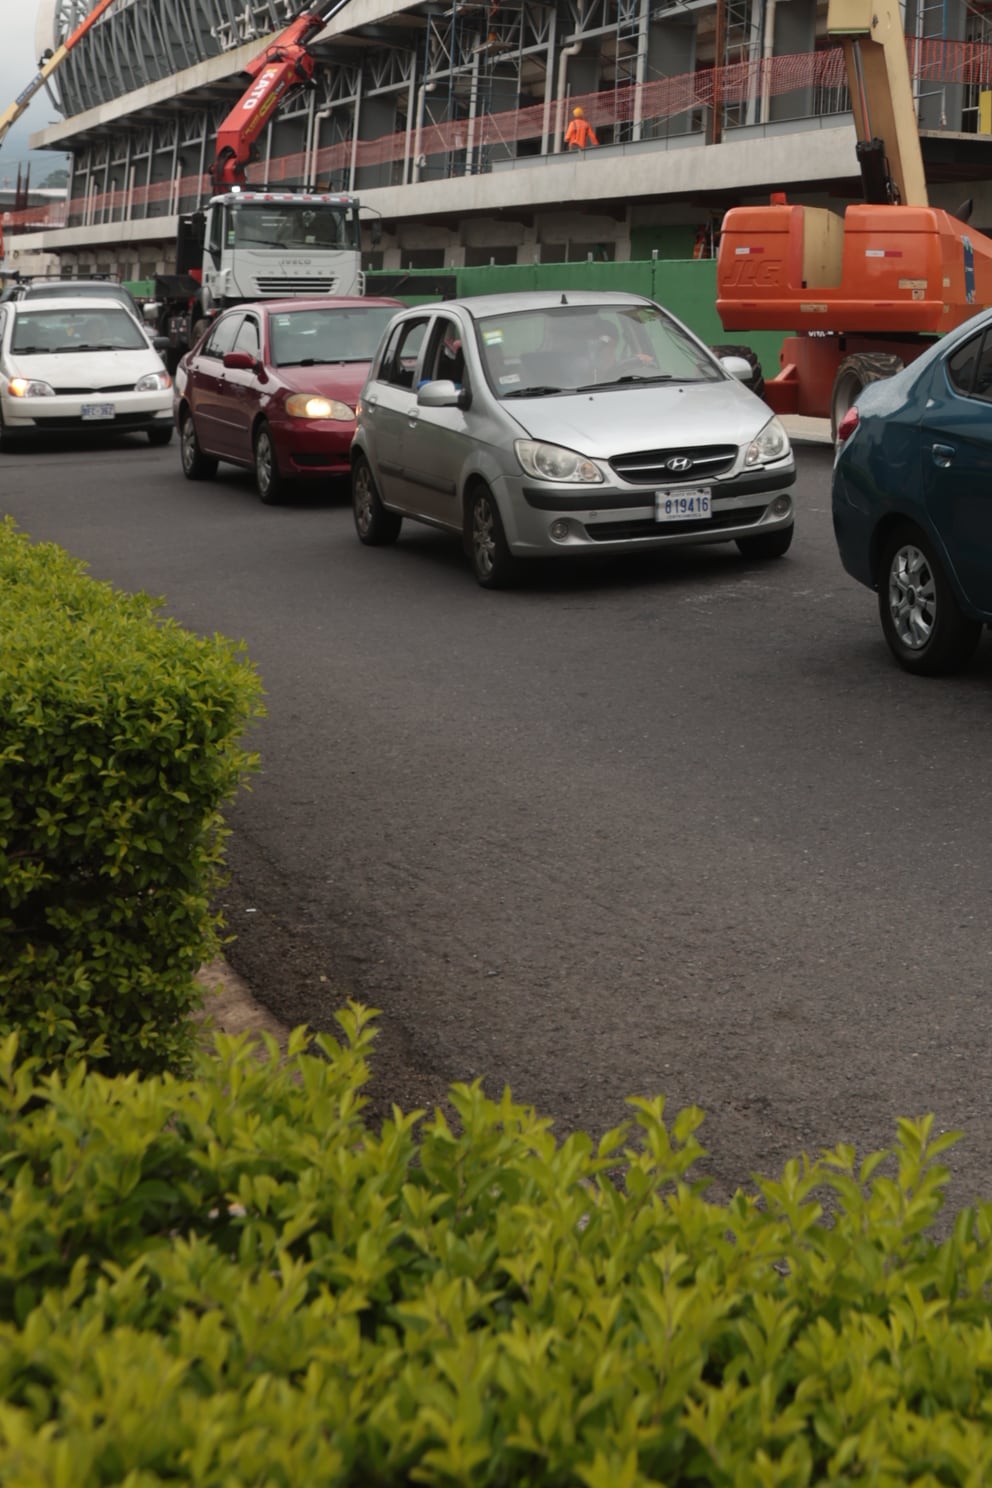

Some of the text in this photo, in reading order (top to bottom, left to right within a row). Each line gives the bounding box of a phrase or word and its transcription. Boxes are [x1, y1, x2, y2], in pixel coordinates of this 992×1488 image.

[243, 71, 275, 110] KATO
[722, 259, 782, 287] JLG
[665, 496, 709, 514] 819416
